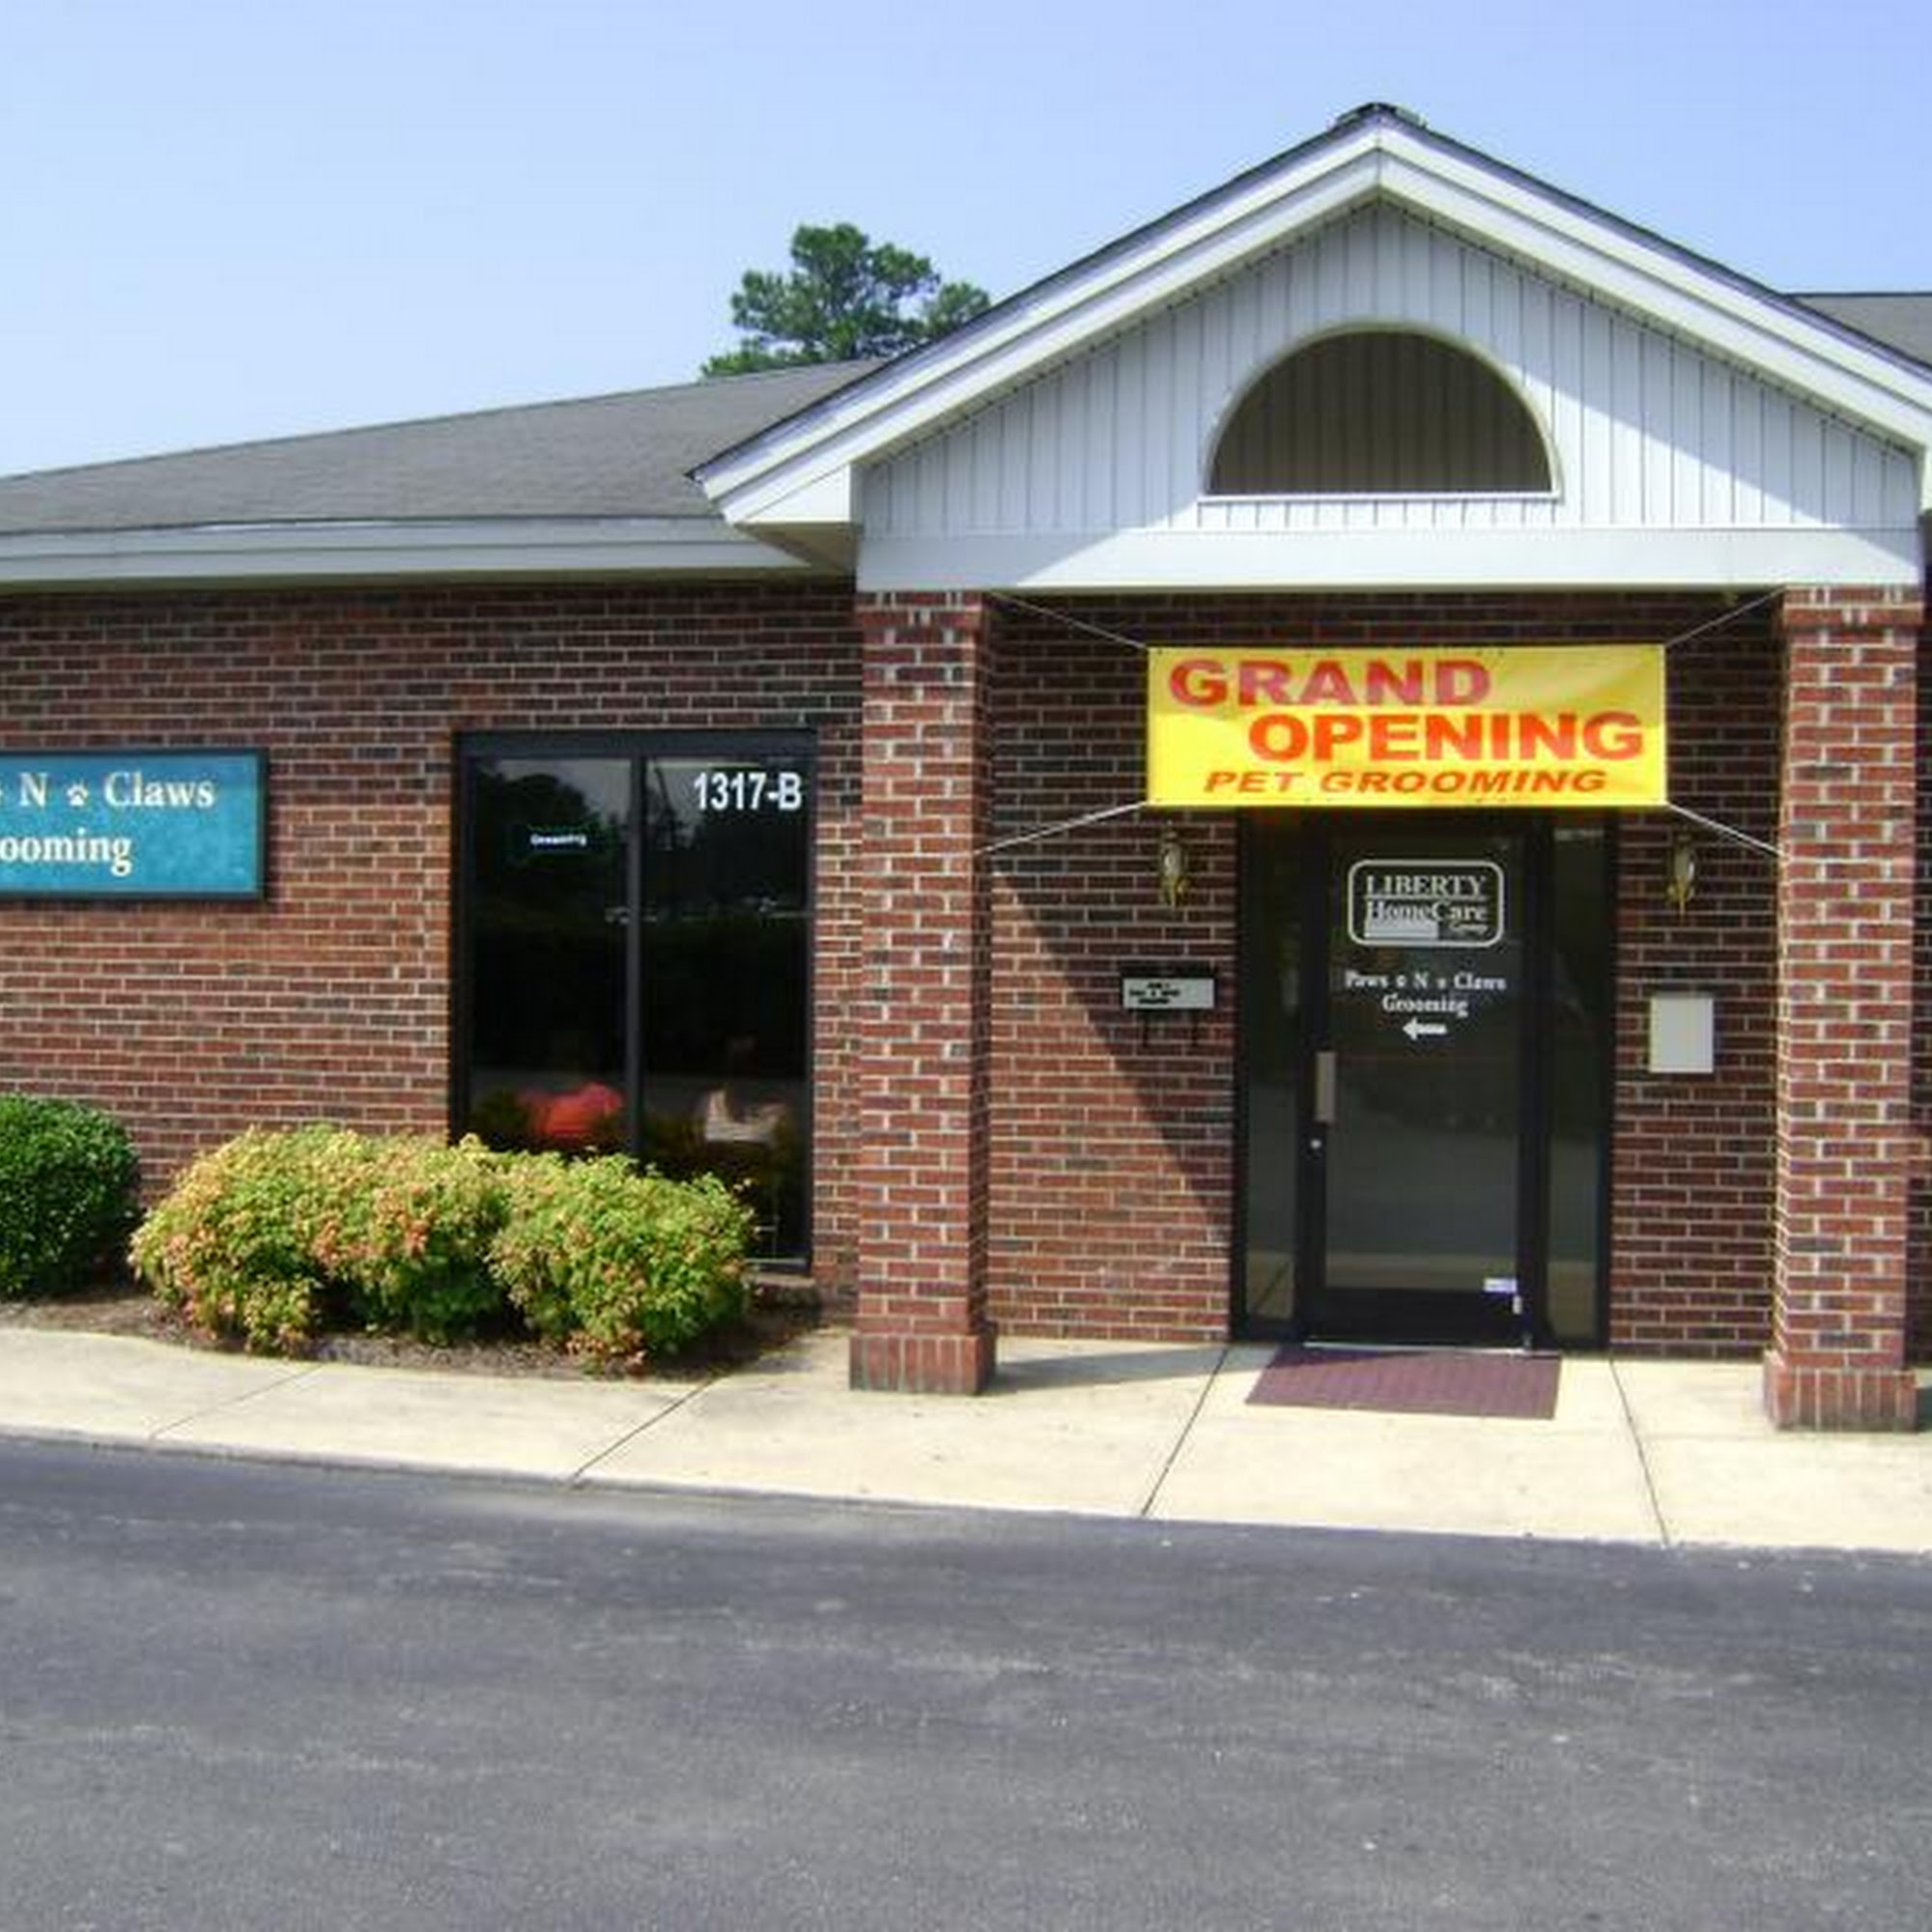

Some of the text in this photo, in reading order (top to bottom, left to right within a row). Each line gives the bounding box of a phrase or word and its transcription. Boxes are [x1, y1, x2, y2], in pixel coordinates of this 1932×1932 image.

[1169, 659, 1491, 706] GRAND
[1248, 711, 1643, 761] OPENING
[18, 771, 215, 808] N Claws
[694, 771, 803, 810] 1317-B
[1204, 770, 1606, 792] PET GROOMING
[1365, 874, 1486, 897] LIBERTY
[1382, 993, 1468, 1017] Grooming
